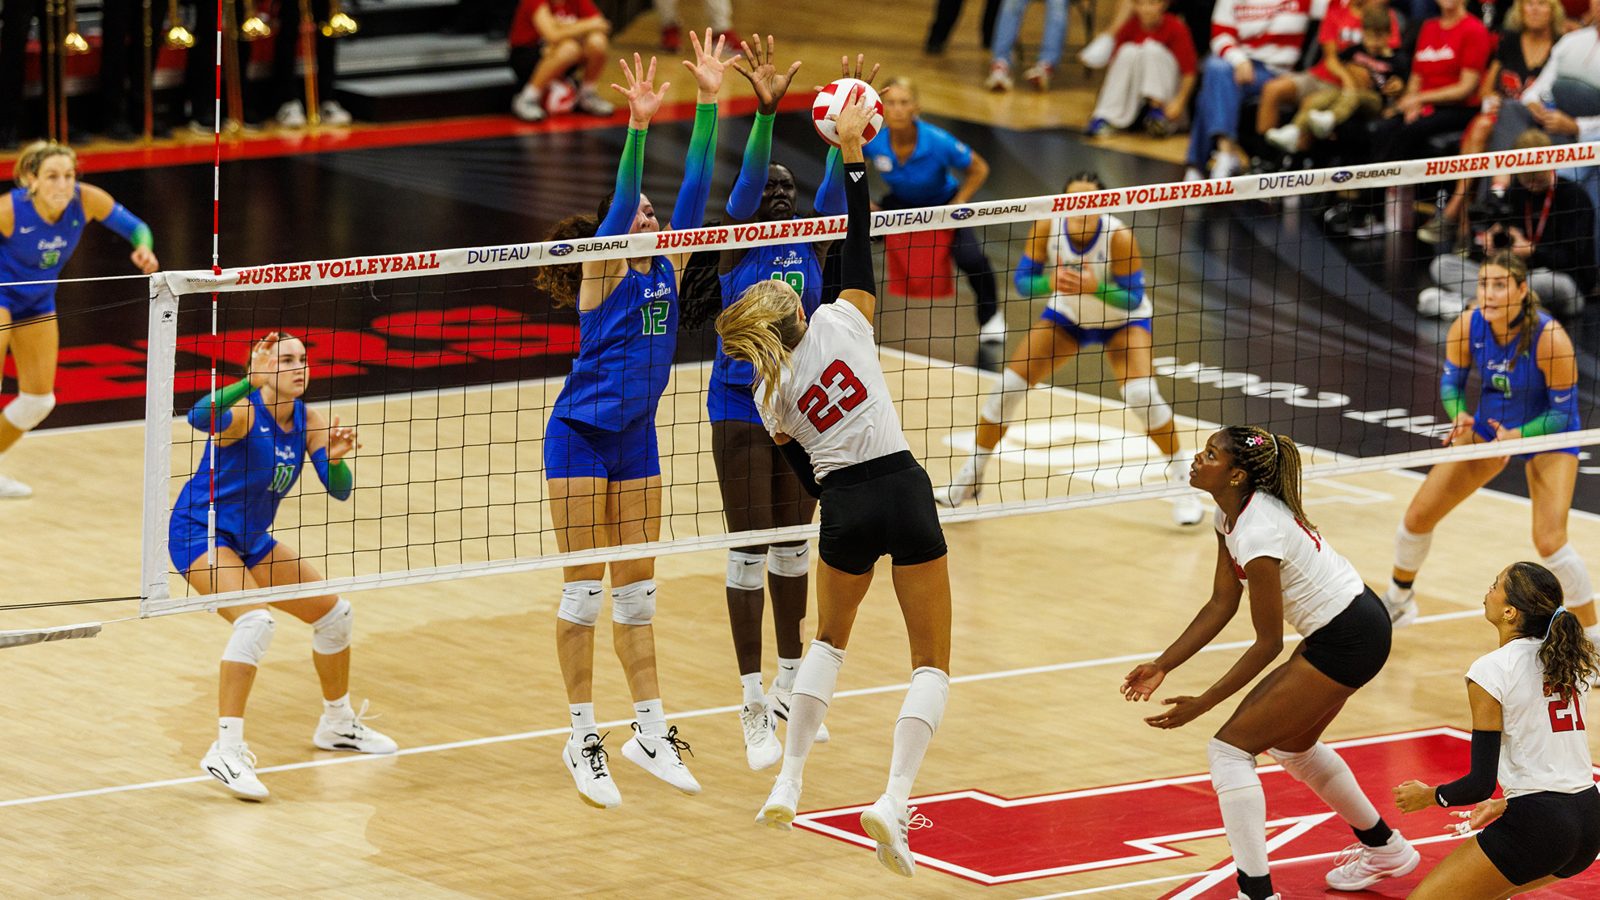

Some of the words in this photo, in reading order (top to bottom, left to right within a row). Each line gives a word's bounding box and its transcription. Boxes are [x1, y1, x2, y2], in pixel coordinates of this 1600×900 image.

[1356, 167, 1402, 180] SUBARU
[1425, 155, 1490, 176] HUSKER
[1495, 145, 1596, 169] VOLLEYBALL
[1259, 173, 1315, 191] DUTEAU
[1051, 192, 1121, 212] HUSKER
[1126, 180, 1234, 205] VOLLEYBALL
[874, 210, 934, 229] DUTEAU
[977, 204, 1027, 217] SUBARU
[576, 239, 629, 253] SUBARU
[656, 231, 729, 249] HUSKER
[733, 217, 848, 243] VOLLEYBALL
[467, 245, 531, 265] DUTEAU
[236, 264, 312, 286] HUSKER
[317, 252, 440, 279] VOLLEYBALL
[643, 286, 671, 299] Eagles
[640, 300, 671, 336] 12
[798, 358, 868, 433] 23
[1491, 373, 1512, 399] 9
[1543, 681, 1586, 732] 21
